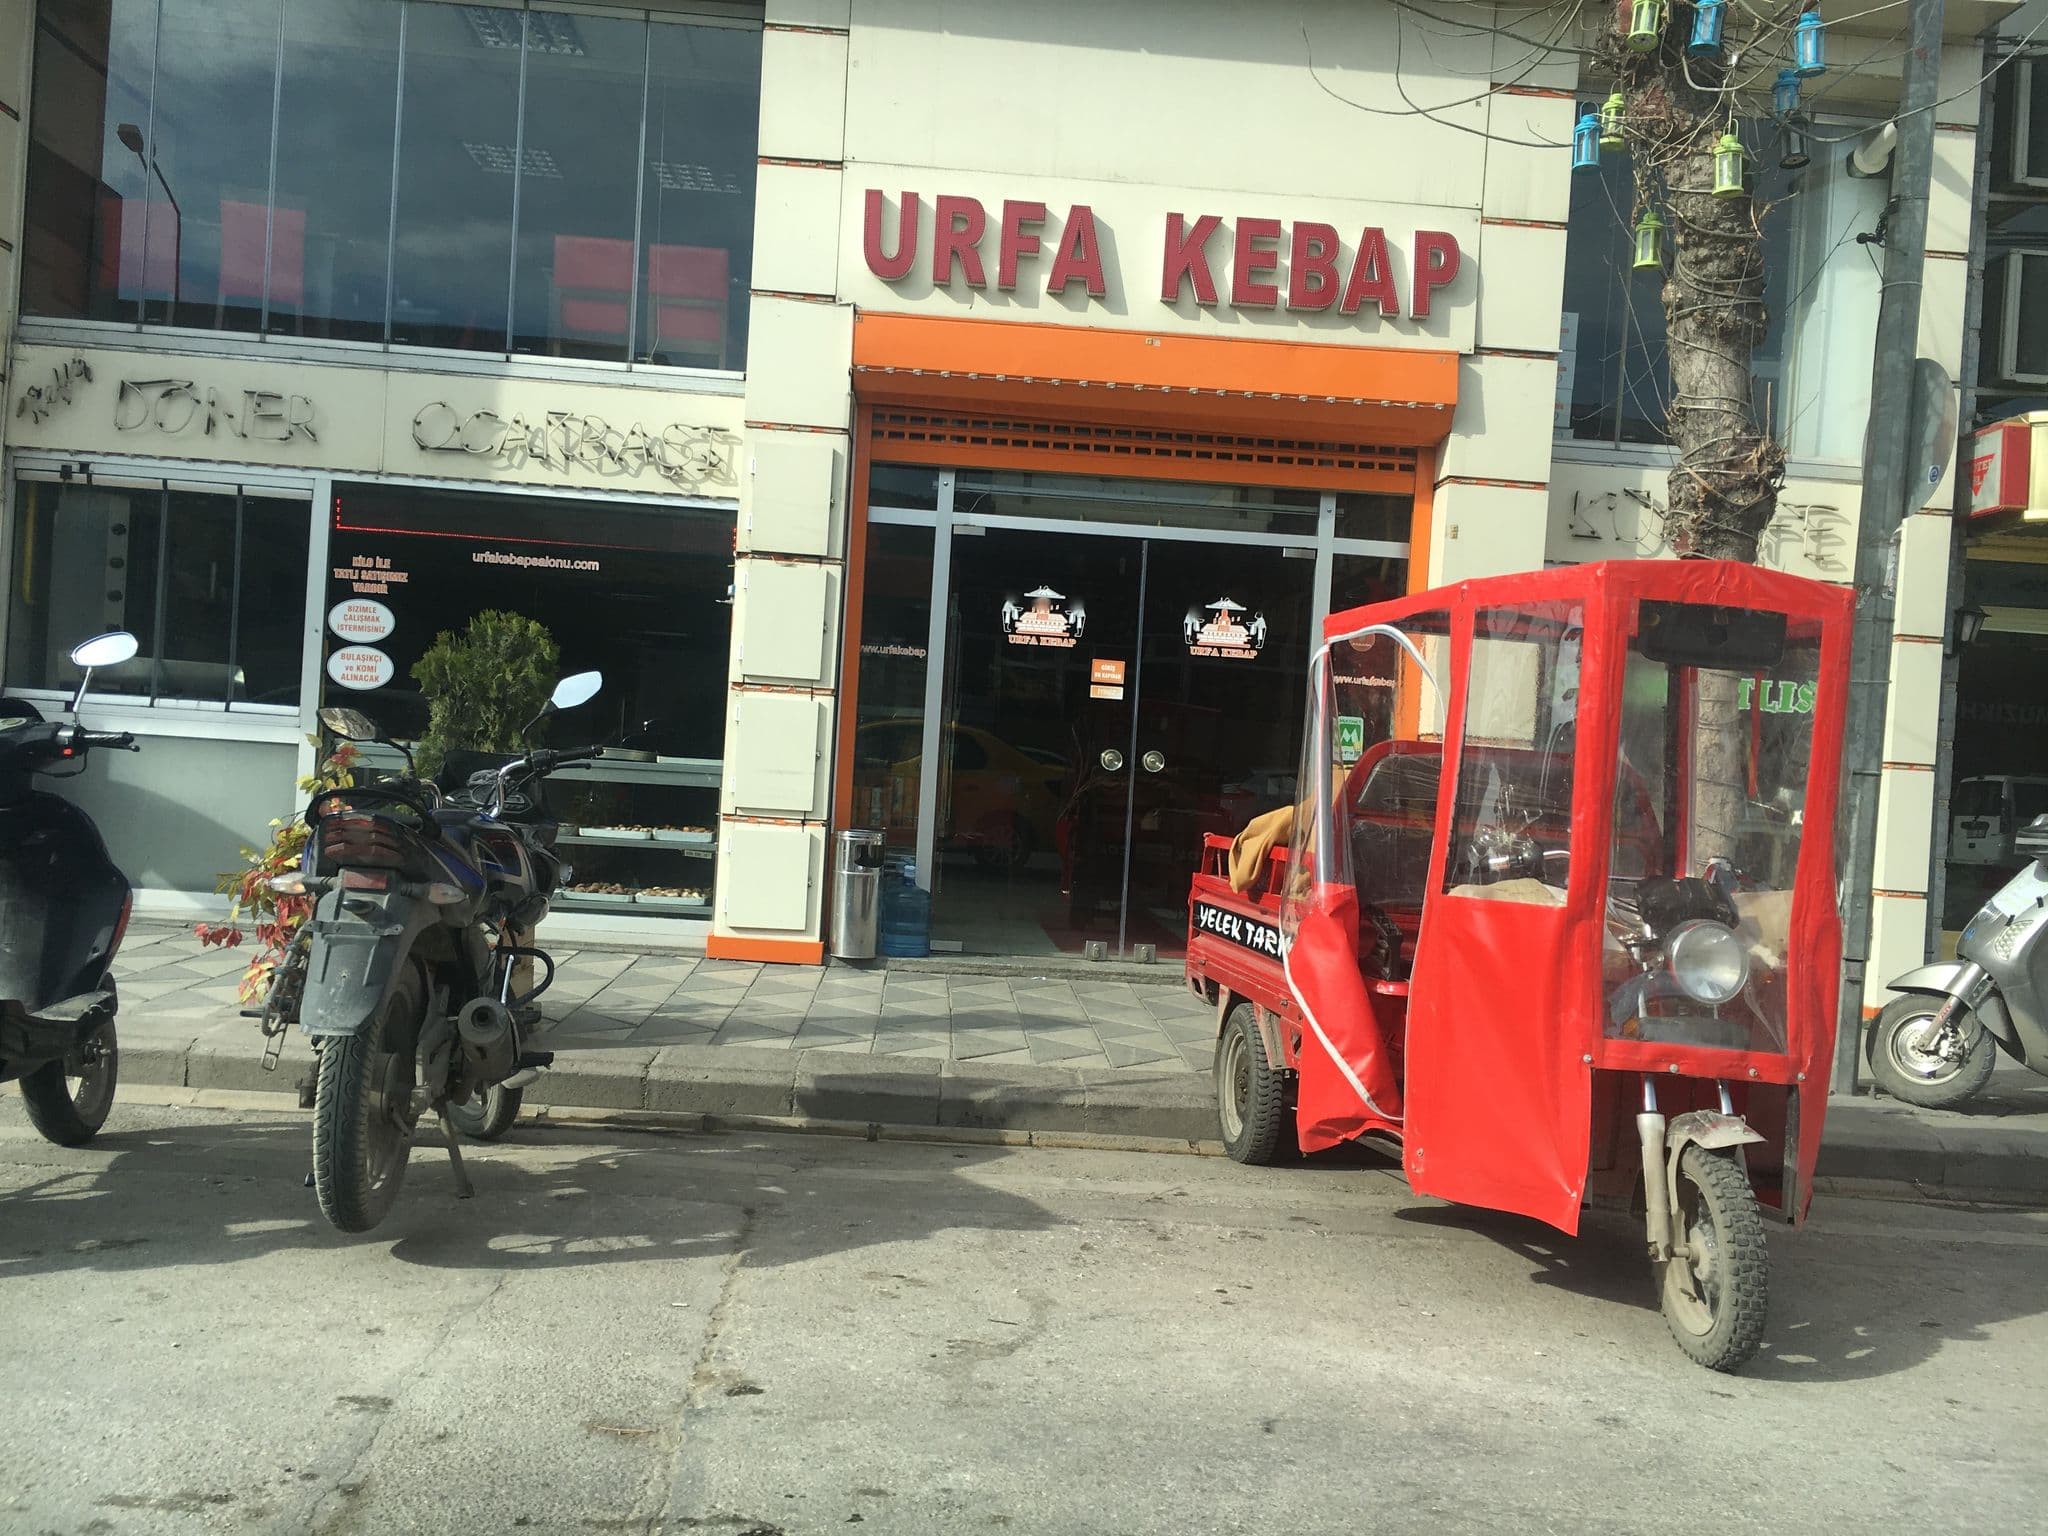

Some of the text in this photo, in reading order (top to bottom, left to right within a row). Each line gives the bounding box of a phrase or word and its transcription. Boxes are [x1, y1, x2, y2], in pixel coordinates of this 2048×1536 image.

[863, 189, 1461, 321] URFA KEBAP
[472, 551, 600, 571] urfakebapsalonu.com
[340, 673, 380, 683] ALINACAK
[1200, 904, 1242, 941] YELEK
